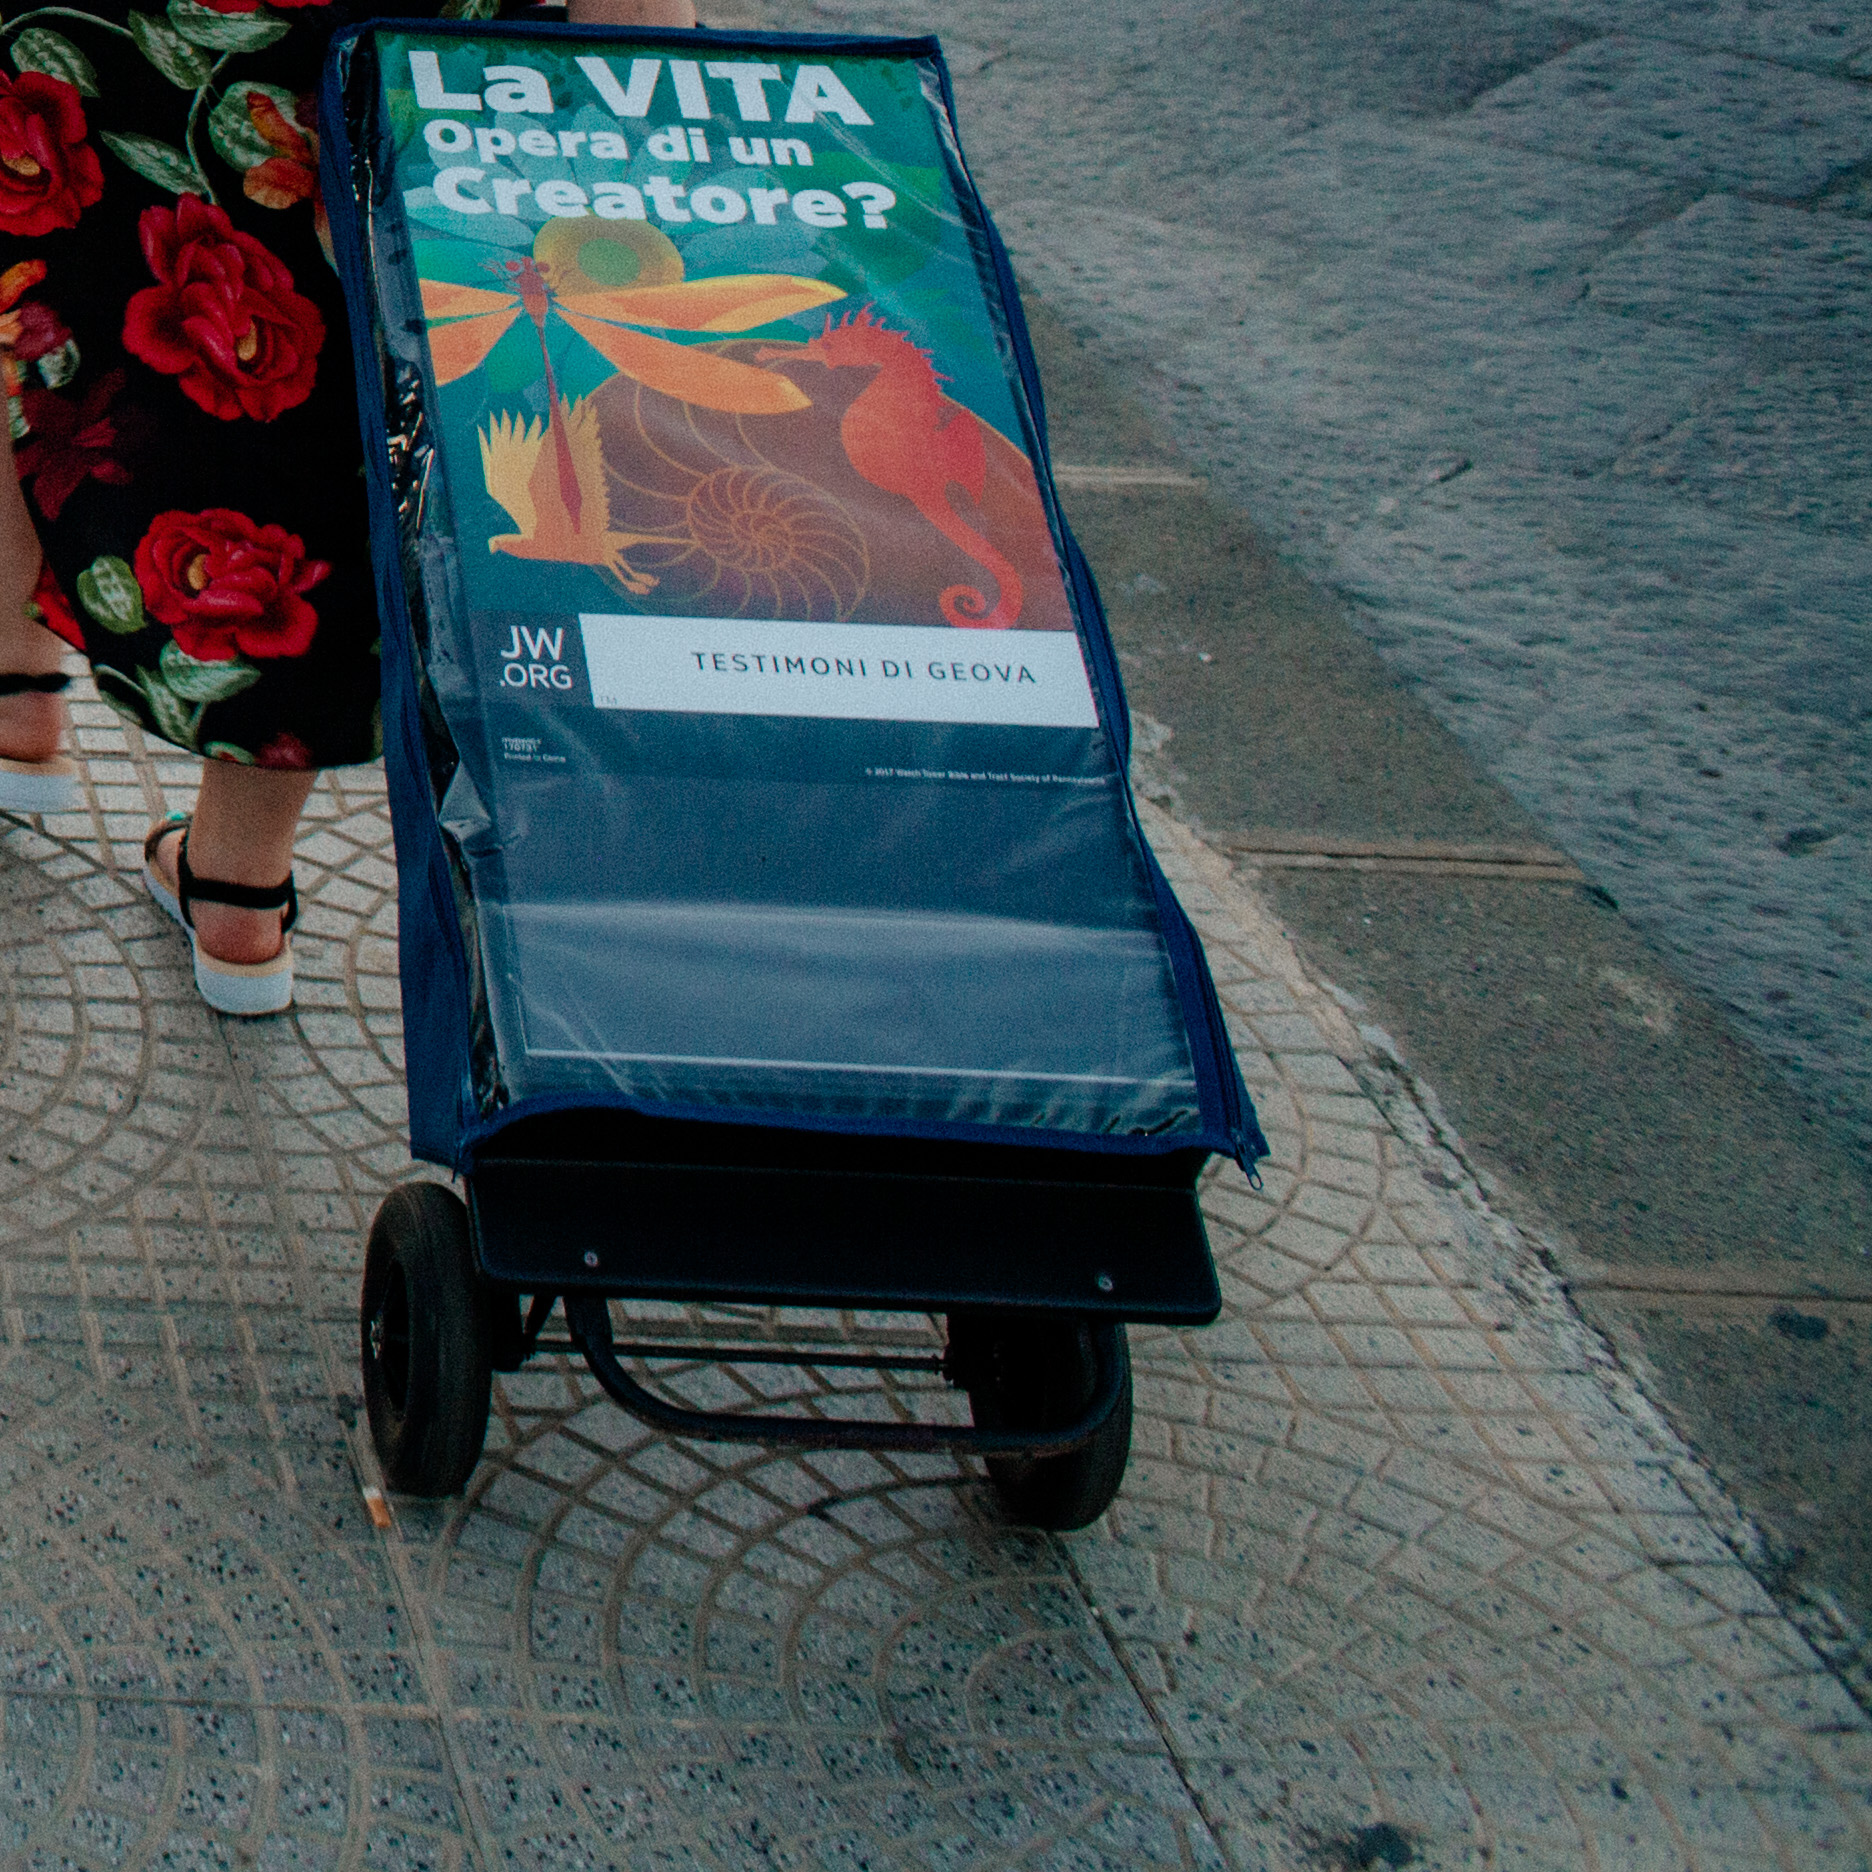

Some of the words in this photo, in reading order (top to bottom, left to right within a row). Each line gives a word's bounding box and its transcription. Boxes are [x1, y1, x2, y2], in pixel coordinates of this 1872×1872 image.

[408, 50, 554, 114] La
[574, 55, 875, 126] VITA
[423, 118, 629, 163] Opera
[647, 125, 711, 163] di
[728, 136, 814, 167] un
[433, 166, 897, 230] Creatore?
[500, 625, 564, 660] JW
[500, 662, 572, 690] .ORG
[691, 651, 867, 677] TESTIMONI
[881, 659, 913, 678] DI
[928, 661, 1037, 684] GEOVA
